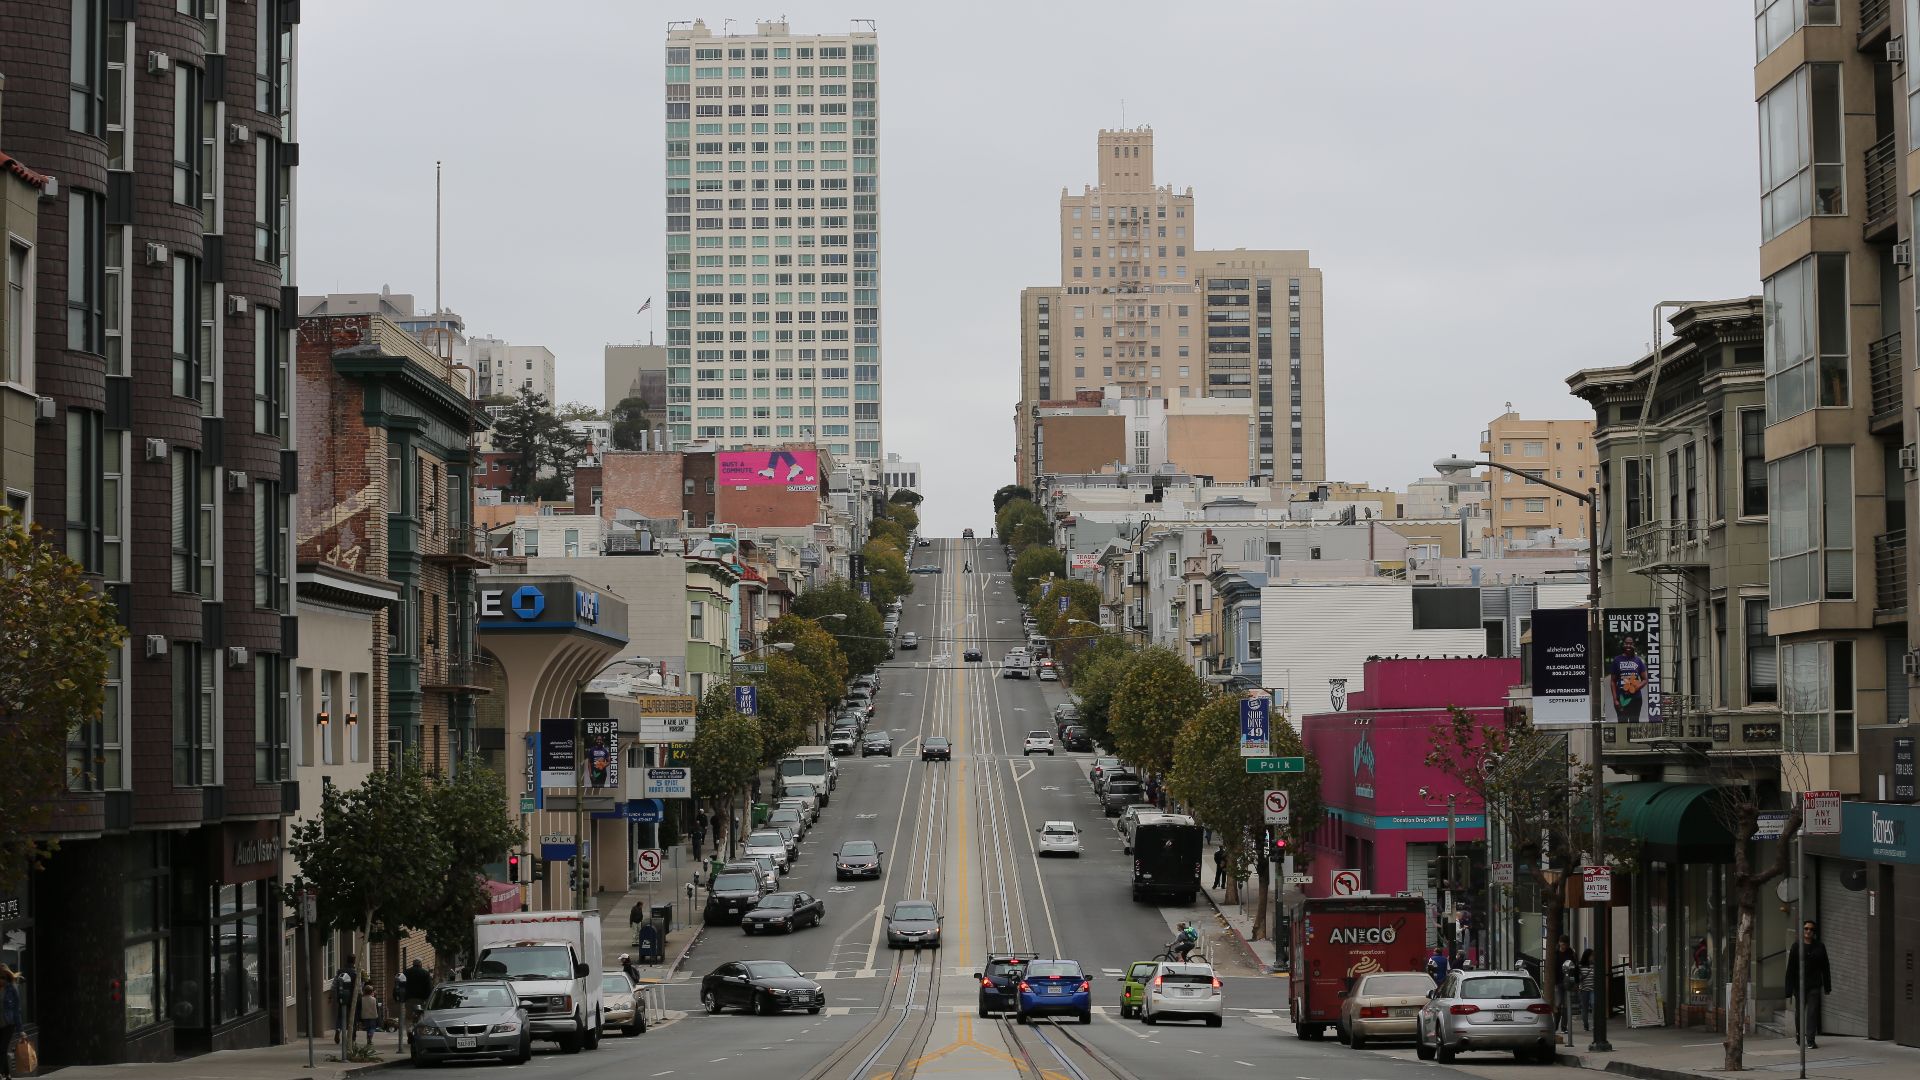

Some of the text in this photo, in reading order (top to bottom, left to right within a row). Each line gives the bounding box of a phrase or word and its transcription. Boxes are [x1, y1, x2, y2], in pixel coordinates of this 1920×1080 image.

[1609, 620, 1646, 633] END
[1647, 612, 1661, 717] ALZHEIMER'S
[587, 726, 610, 734] END
[1247, 727, 1263, 737] 49
[610, 721, 618, 784] ALZHEIMER'S
[1260, 761, 1290, 769] Polk
[1805, 798, 1839, 809] NO STOPPING
[1815, 809, 1831, 817] ANY
[1814, 817, 1832, 826] TIME
[1329, 927, 1396, 944] AN THE GO
